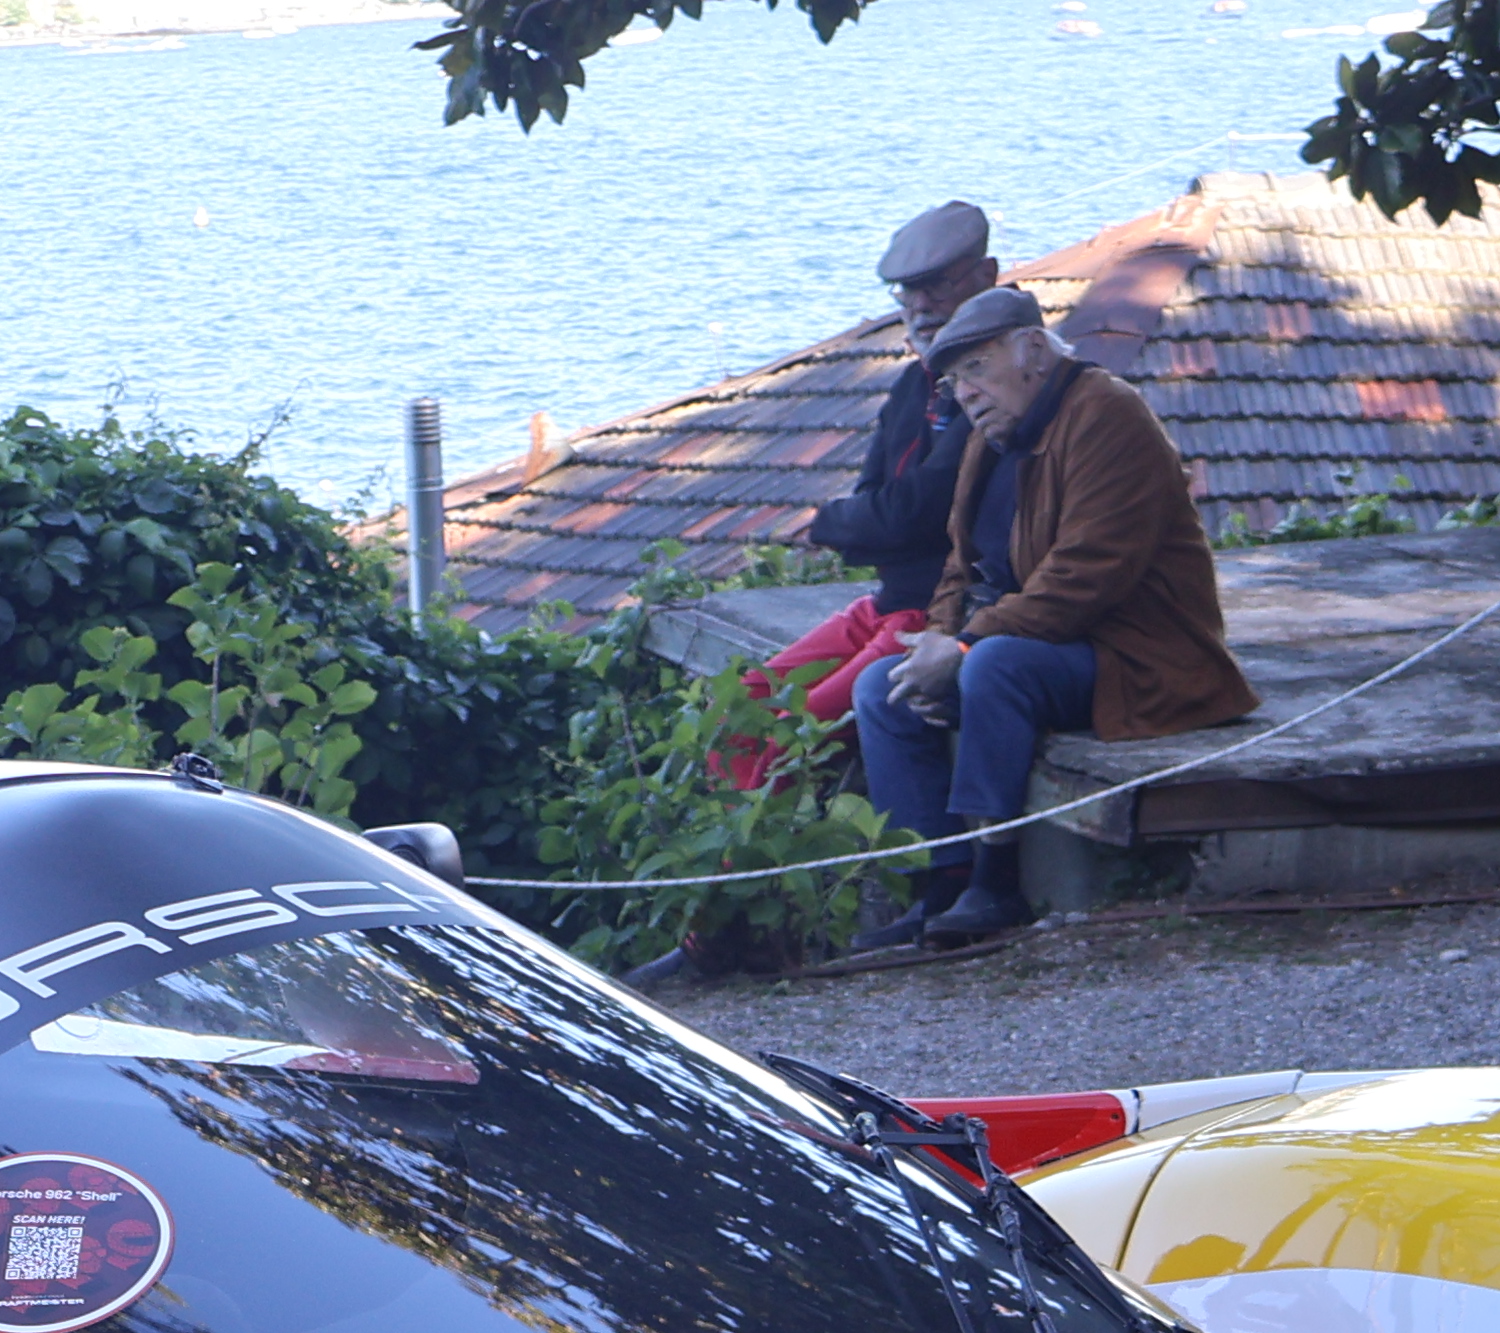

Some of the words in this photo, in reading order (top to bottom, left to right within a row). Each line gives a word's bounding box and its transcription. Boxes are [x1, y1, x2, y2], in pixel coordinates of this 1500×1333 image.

[44, 1189, 73, 1200] 962
[12, 1214, 46, 1224] SCAN
[47, 1215, 86, 1225] HERE!
